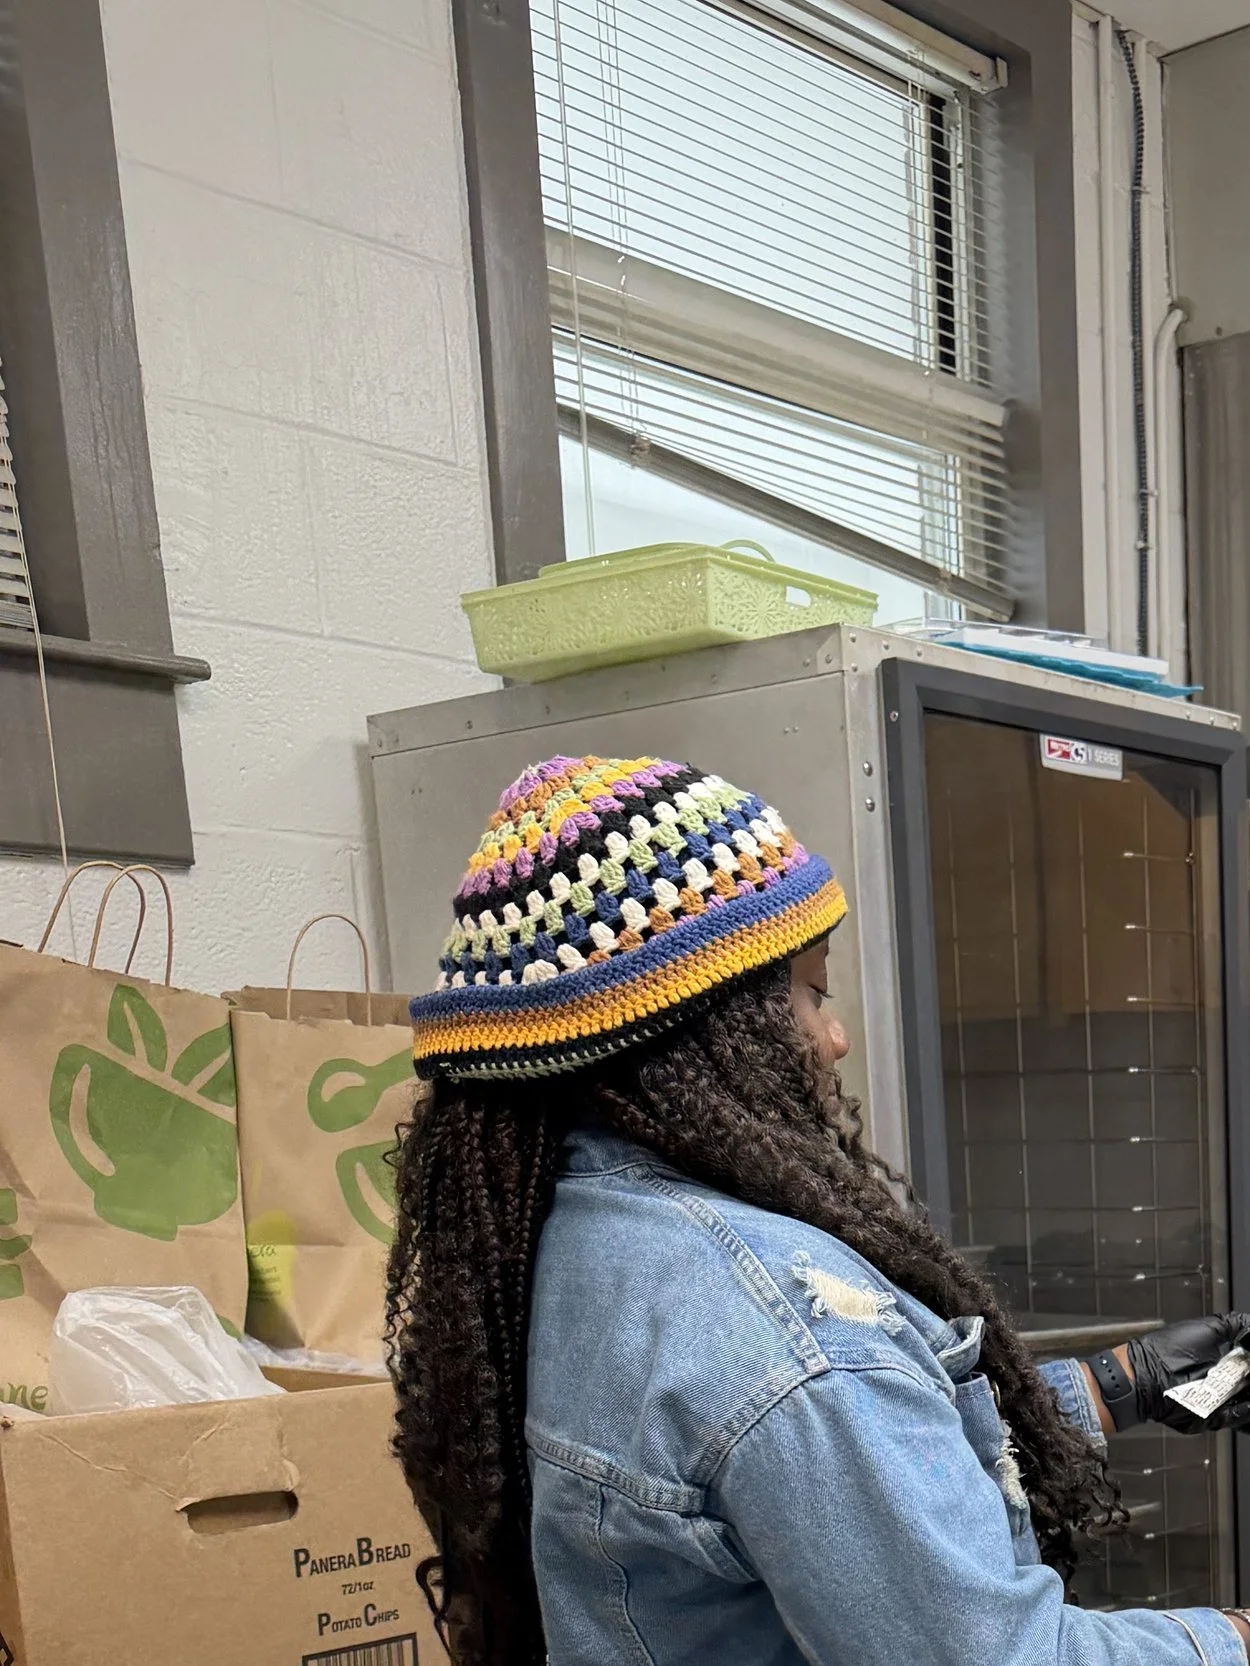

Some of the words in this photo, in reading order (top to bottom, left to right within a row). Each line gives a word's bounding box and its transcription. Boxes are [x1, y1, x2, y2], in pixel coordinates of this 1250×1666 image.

[293, 1547, 358, 1578] PANERA
[355, 1537, 412, 1567] BREAD
[316, 1612, 363, 1636] POTATO
[363, 1603, 401, 1627] CHIPS
